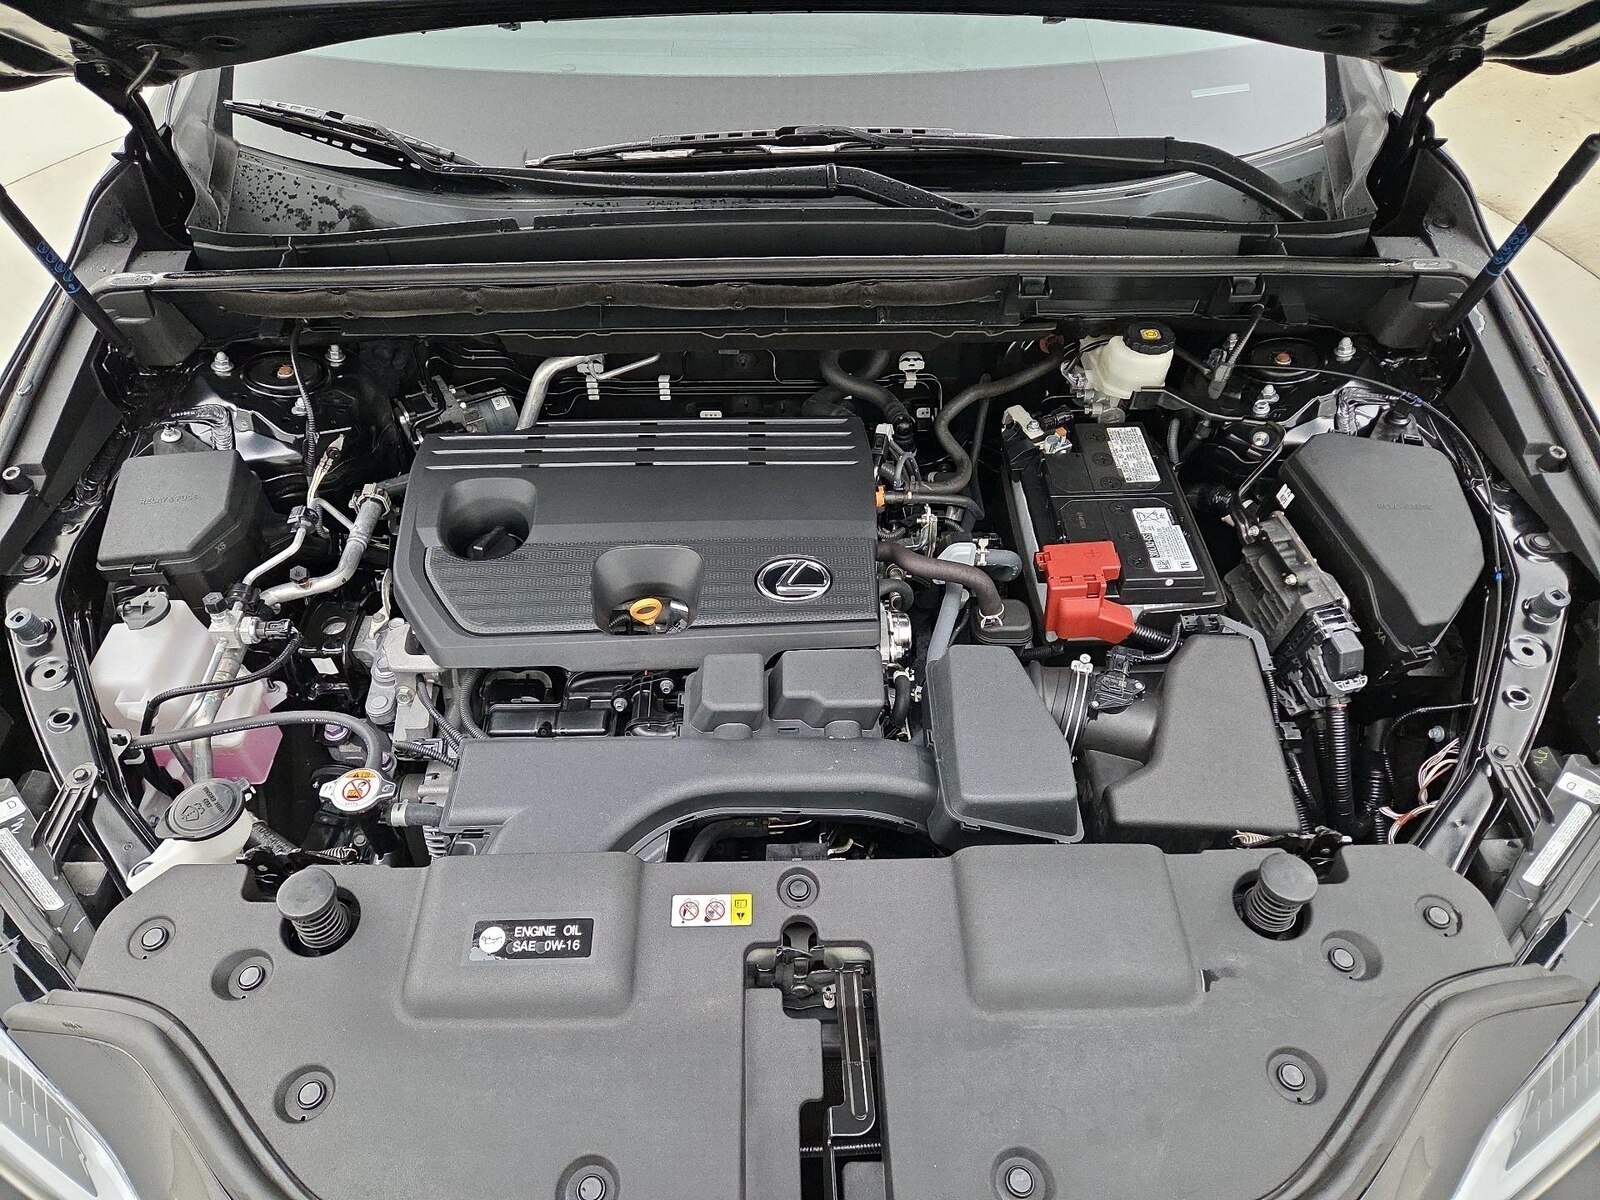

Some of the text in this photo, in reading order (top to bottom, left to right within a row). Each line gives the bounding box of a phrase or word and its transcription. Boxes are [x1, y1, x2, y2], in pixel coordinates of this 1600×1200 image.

[514, 924, 582, 938] ENGINE OIL
[512, 940, 580, 952] SAE 0W-16
